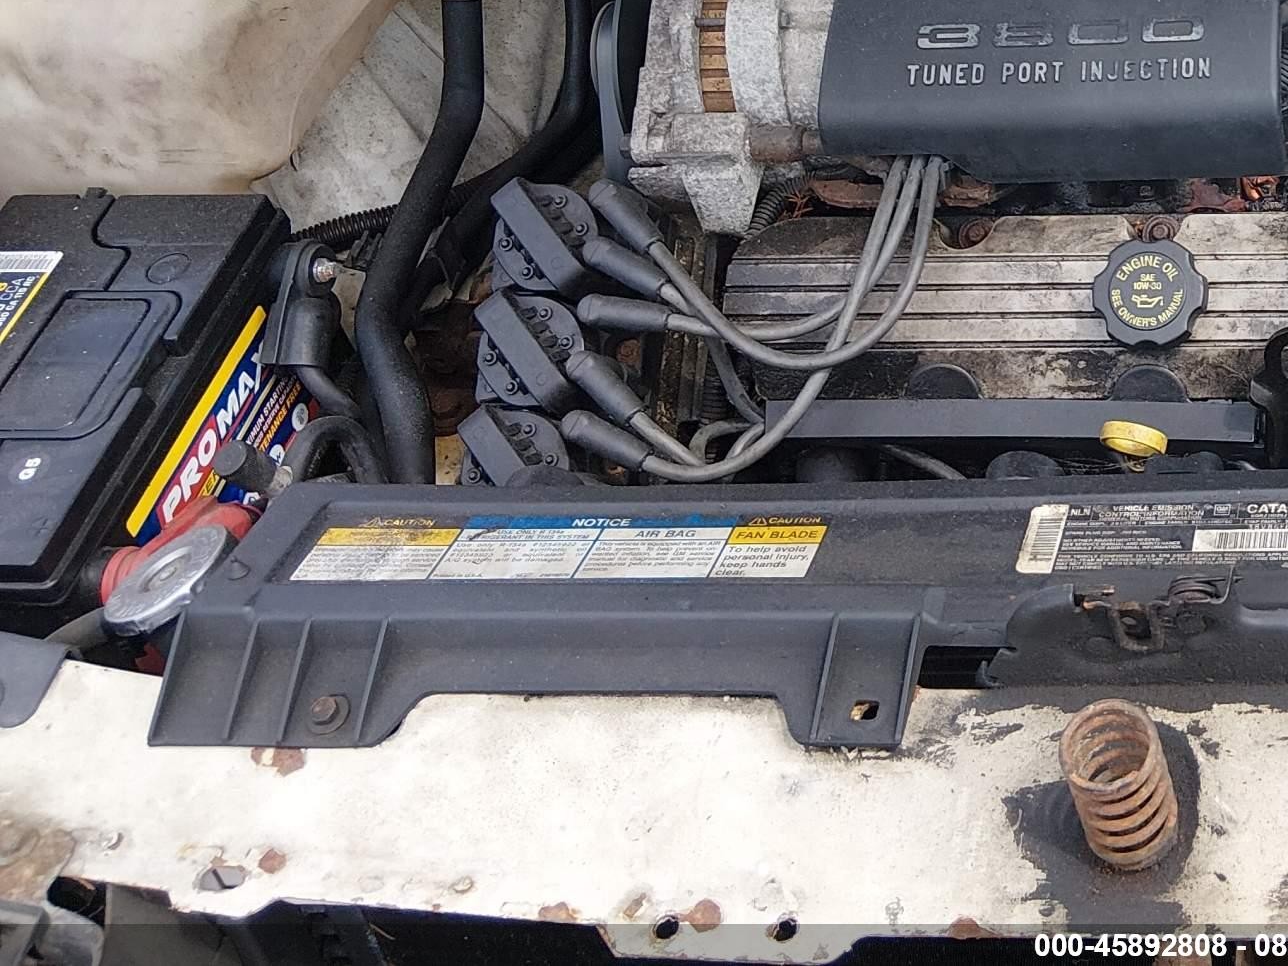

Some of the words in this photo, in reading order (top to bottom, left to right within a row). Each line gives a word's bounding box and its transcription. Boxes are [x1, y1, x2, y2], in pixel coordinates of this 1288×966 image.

[907, 62, 985, 86] TUNED
[1002, 61, 1064, 83] PORT
[1081, 57, 1211, 82] INJECTION
[1116, 255, 1162, 281] ENGINE
[1162, 262, 1179, 283] OIL
[1133, 282, 1162, 290] 10W-30
[1111, 289, 1122, 308] SEE
[1119, 307, 1158, 327] OWNER'S
[1158, 289, 1183, 323] MANUAL
[1070, 508, 1091, 517] NLN
[572, 518, 631, 527] NOTICE
[768, 516, 821, 524] CAUTION
[635, 530, 659, 538] AIR
[664, 530, 697, 538] BAG
[736, 531, 766, 539] FAN
[769, 530, 818, 539] BLADE
[746, 546, 772, 554] help
[774, 545, 808, 553] avoid
[723, 553, 773, 562] personal
[720, 561, 748, 569] keep
